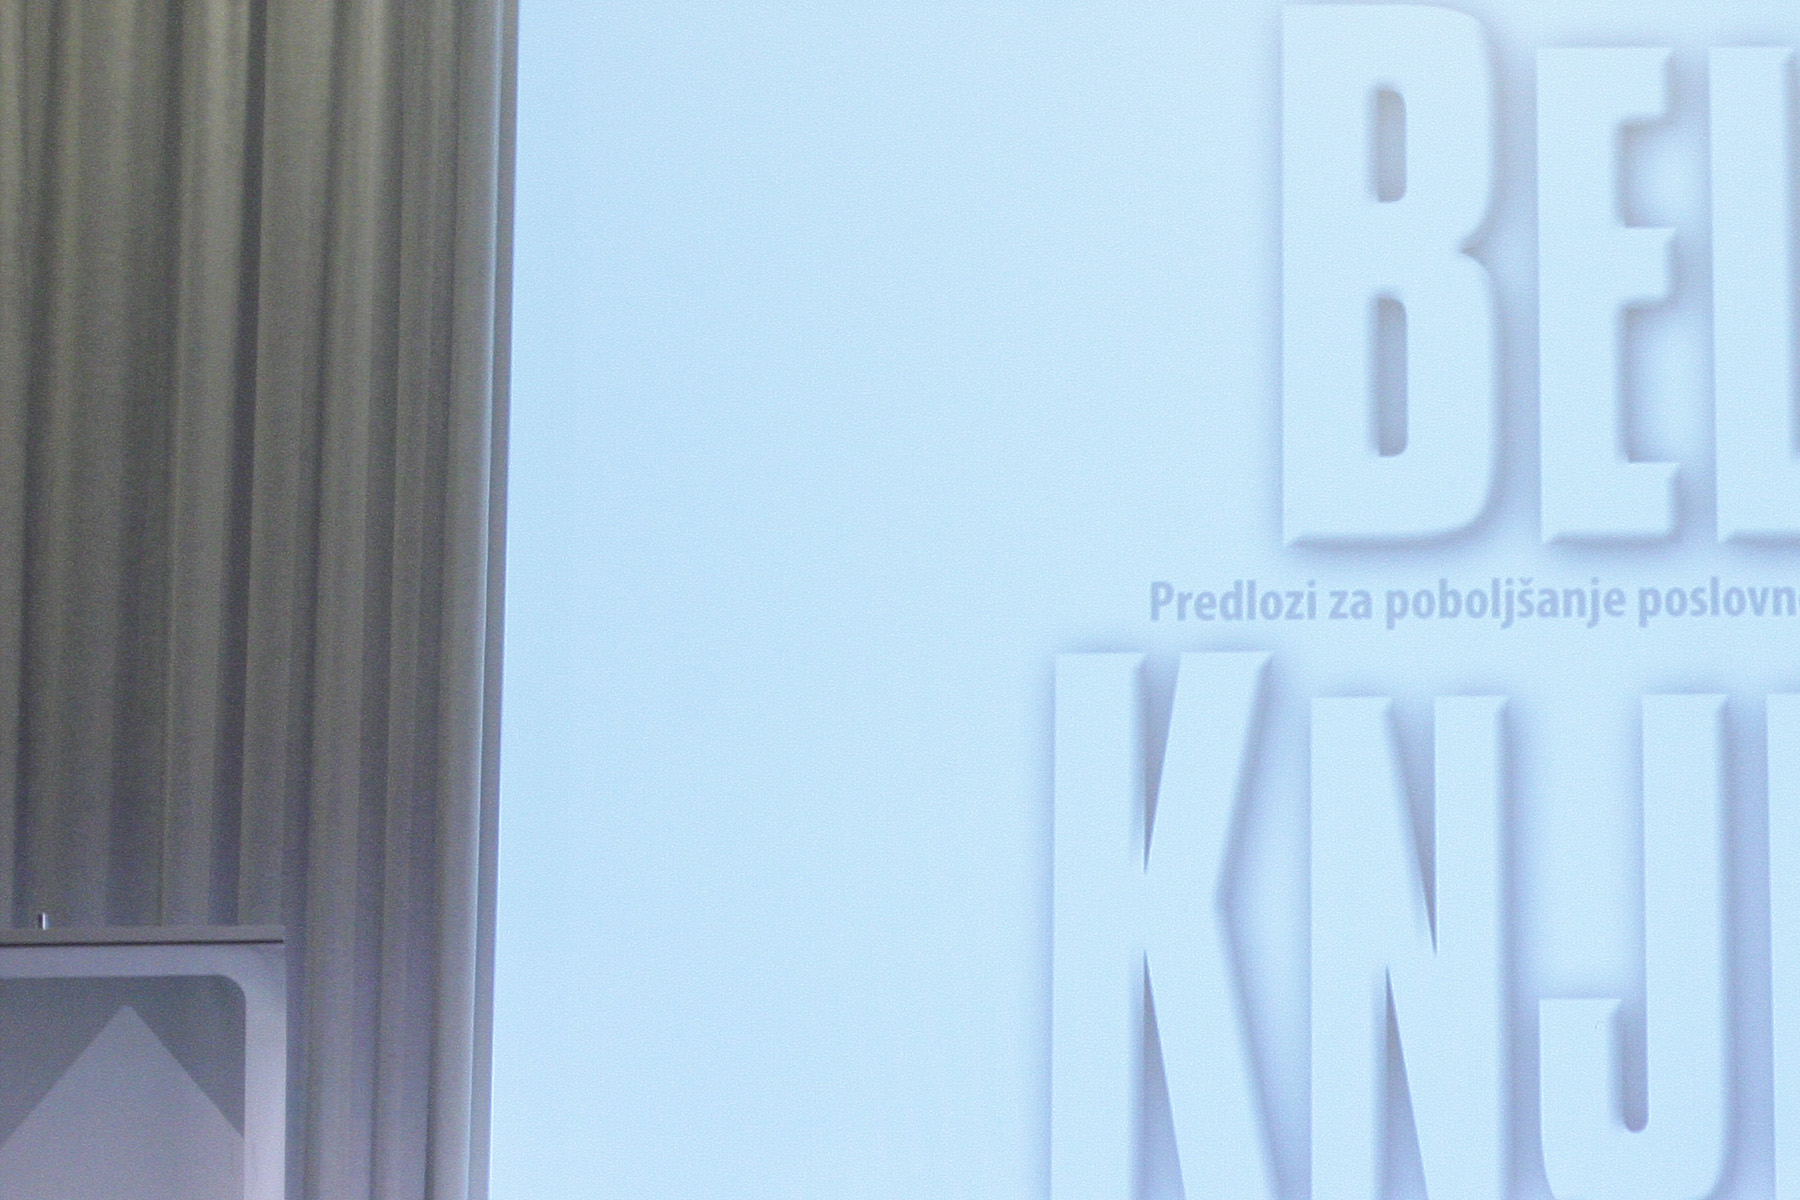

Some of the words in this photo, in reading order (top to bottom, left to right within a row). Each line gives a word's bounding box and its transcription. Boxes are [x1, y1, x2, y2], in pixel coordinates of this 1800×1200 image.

[1149, 579, 1317, 622] Predlozi
[1328, 588, 1373, 621] za
[1386, 577, 1626, 631] poboljšanje
